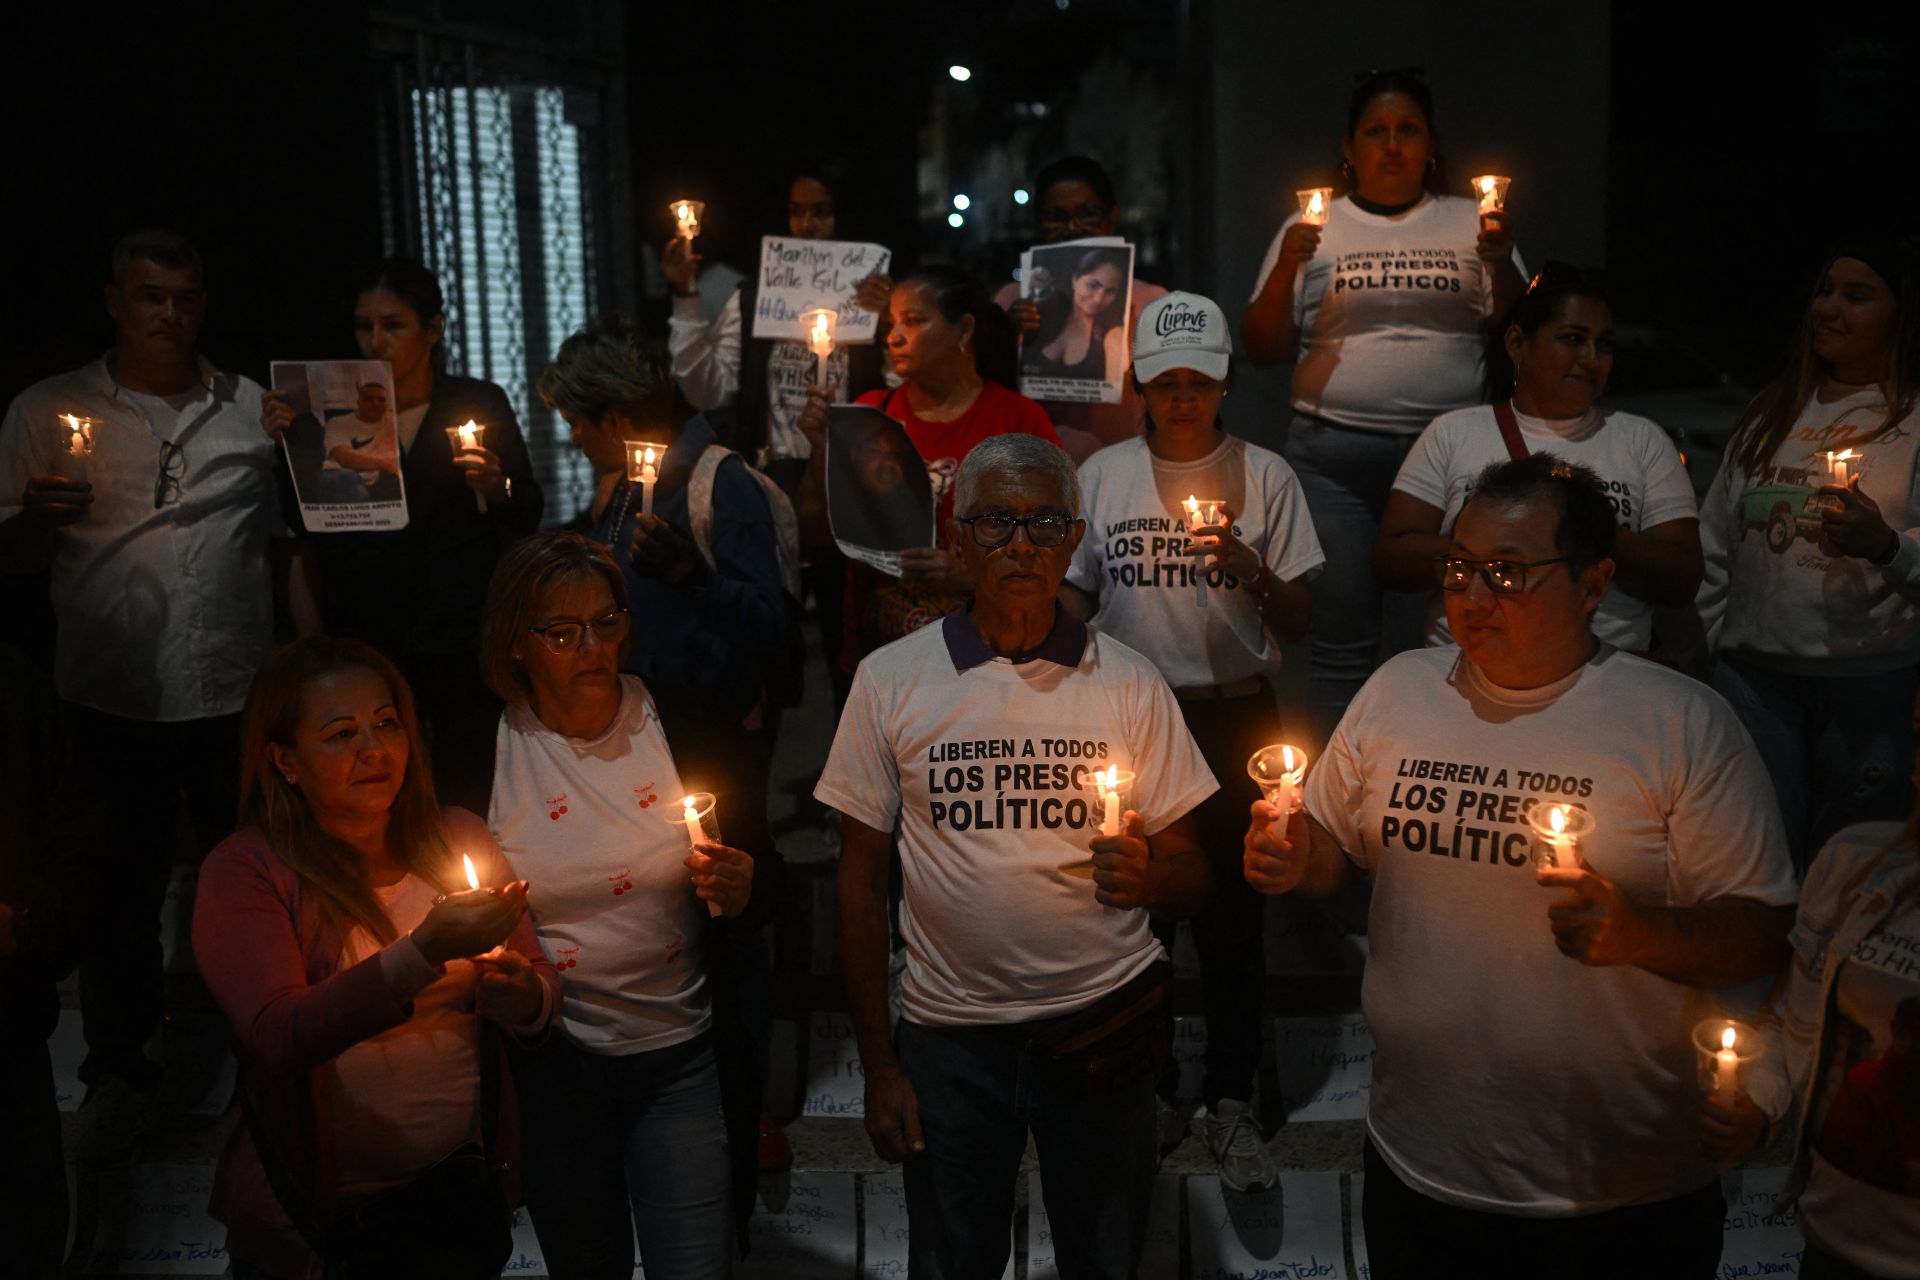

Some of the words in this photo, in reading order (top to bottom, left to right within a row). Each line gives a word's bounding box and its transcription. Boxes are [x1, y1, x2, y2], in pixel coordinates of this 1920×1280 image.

[1336, 261, 1373, 273] LOS
[1381, 260, 1459, 271] PRESOS
[1337, 251, 1394, 262] LIBEREN
[1412, 249, 1457, 259] TODOS
[1335, 271, 1461, 293] POLÍTICOS
[1106, 518, 1170, 538] LIBEREN
[1174, 519, 1186, 533] A
[1106, 536, 1144, 561] LOS
[1152, 536, 1196, 558] PRE
[929, 739, 1015, 762] LIBEREN
[1021, 738, 1036, 757] A
[1041, 738, 1109, 760] TODOS
[928, 765, 984, 794] LOS
[994, 763, 1104, 791] PRESO
[1397, 758, 1489, 786] LIBEREN
[1492, 768, 1508, 789] A
[1517, 770, 1593, 798] TODOS
[929, 791, 1098, 831] POLÍTICO
[1388, 782, 1448, 814] LOS
[1456, 789, 1582, 827] PRES
[1381, 815, 1545, 867] POLÍTIC
